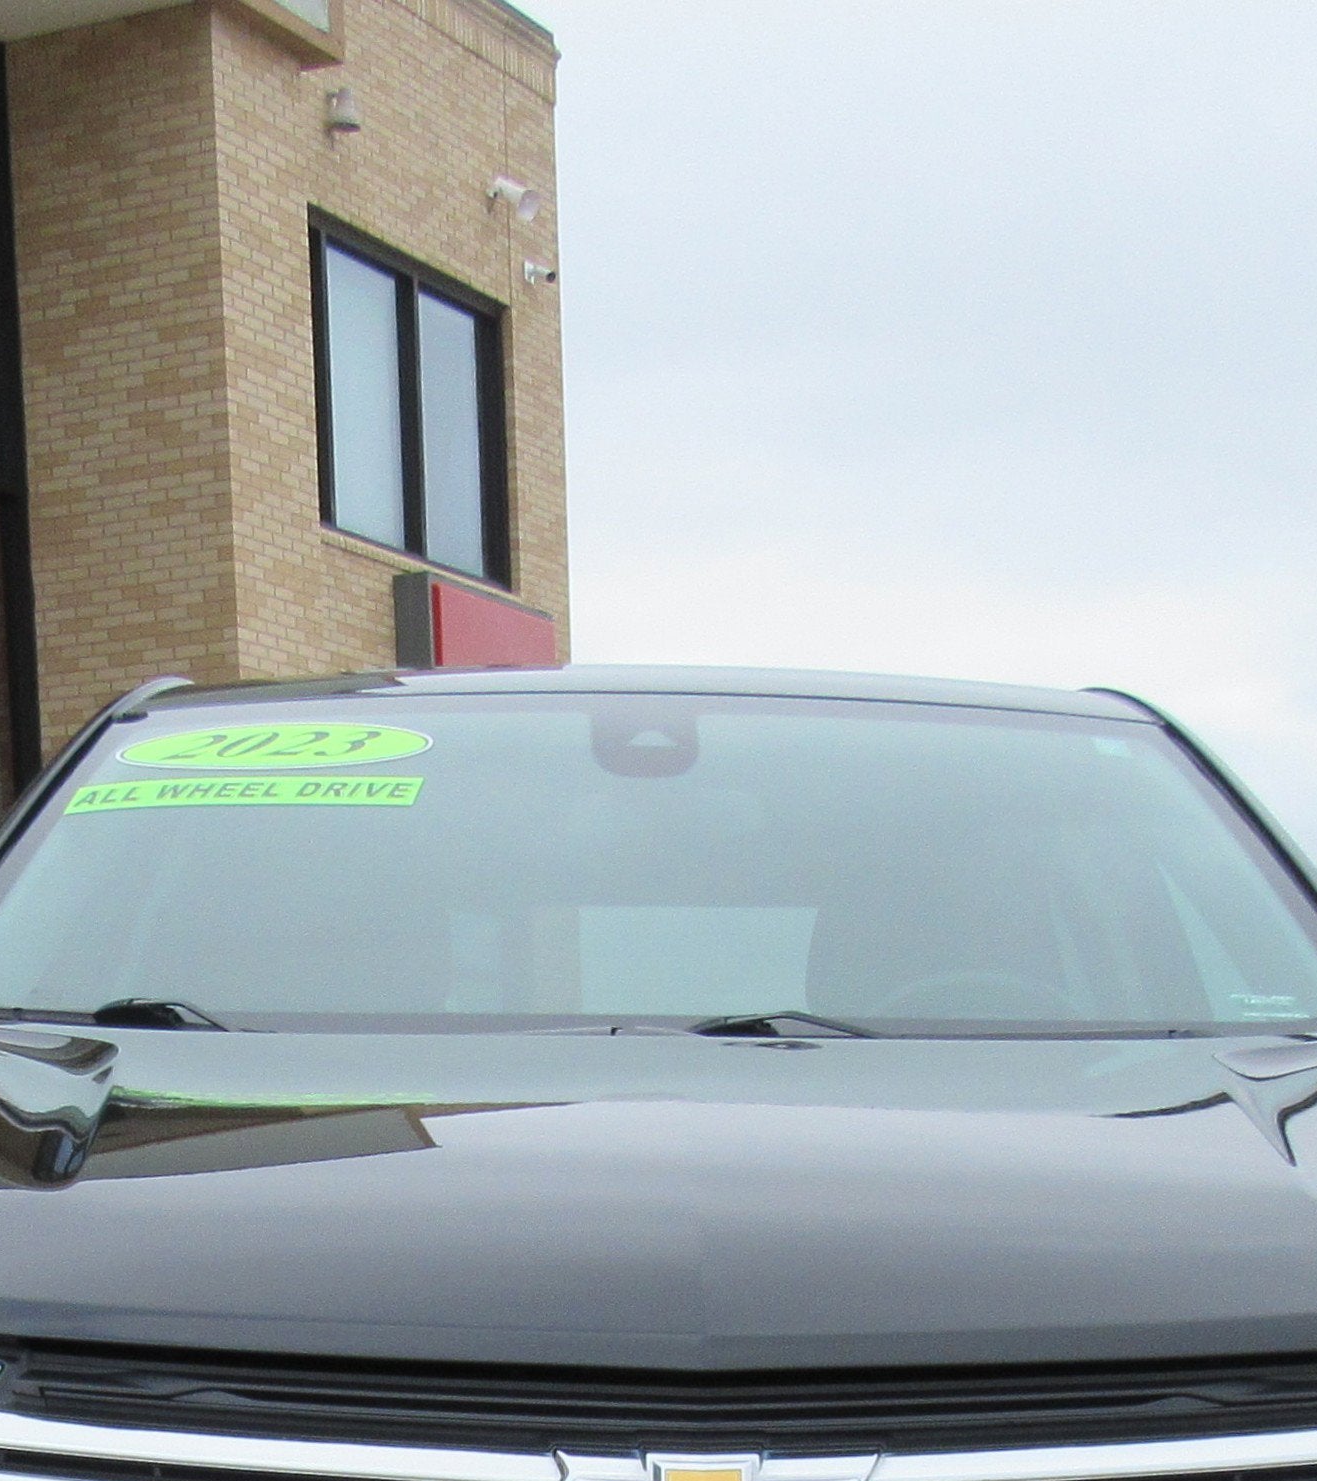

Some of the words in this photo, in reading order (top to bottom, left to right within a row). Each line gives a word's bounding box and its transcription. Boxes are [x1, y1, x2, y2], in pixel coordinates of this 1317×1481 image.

[159, 730, 381, 760] 2023
[73, 785, 141, 808] ALL
[157, 781, 279, 800] WHEEL
[294, 780, 414, 799] DRIVE
